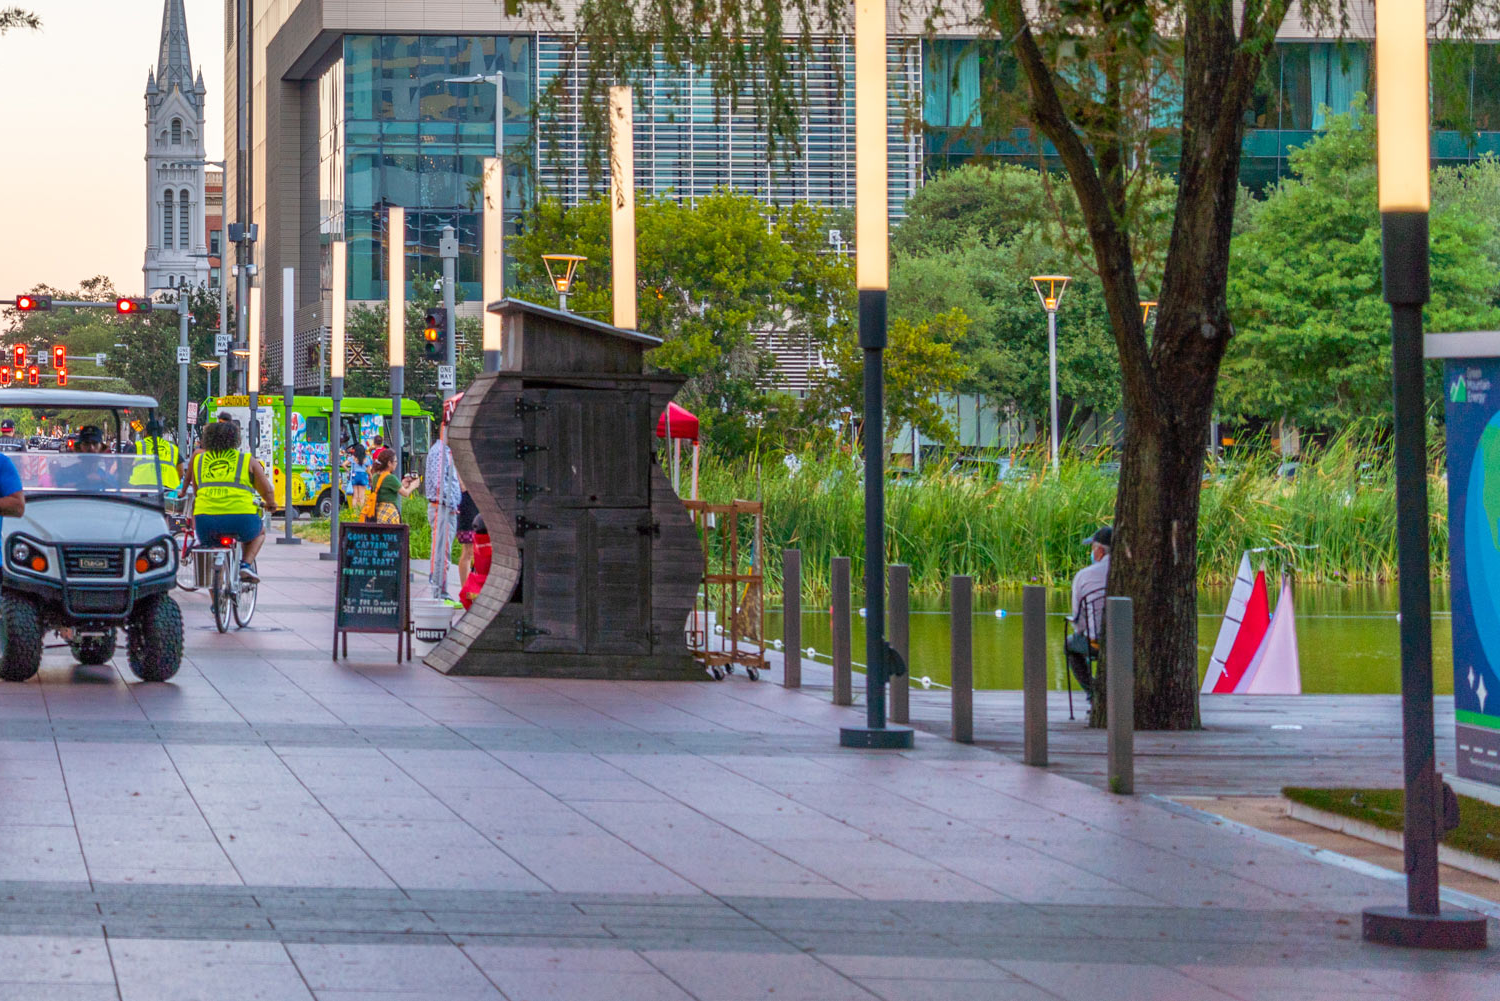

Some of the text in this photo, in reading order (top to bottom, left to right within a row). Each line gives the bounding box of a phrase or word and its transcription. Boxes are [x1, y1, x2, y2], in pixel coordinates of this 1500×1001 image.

[347, 532, 368, 541] COME
[355, 541, 389, 549] CAPTAIN
[382, 550, 399, 558] OWN
[352, 556, 369, 565] SAIL
[357, 606, 397, 615] ATTENDANT
[417, 630, 445, 639] HART
